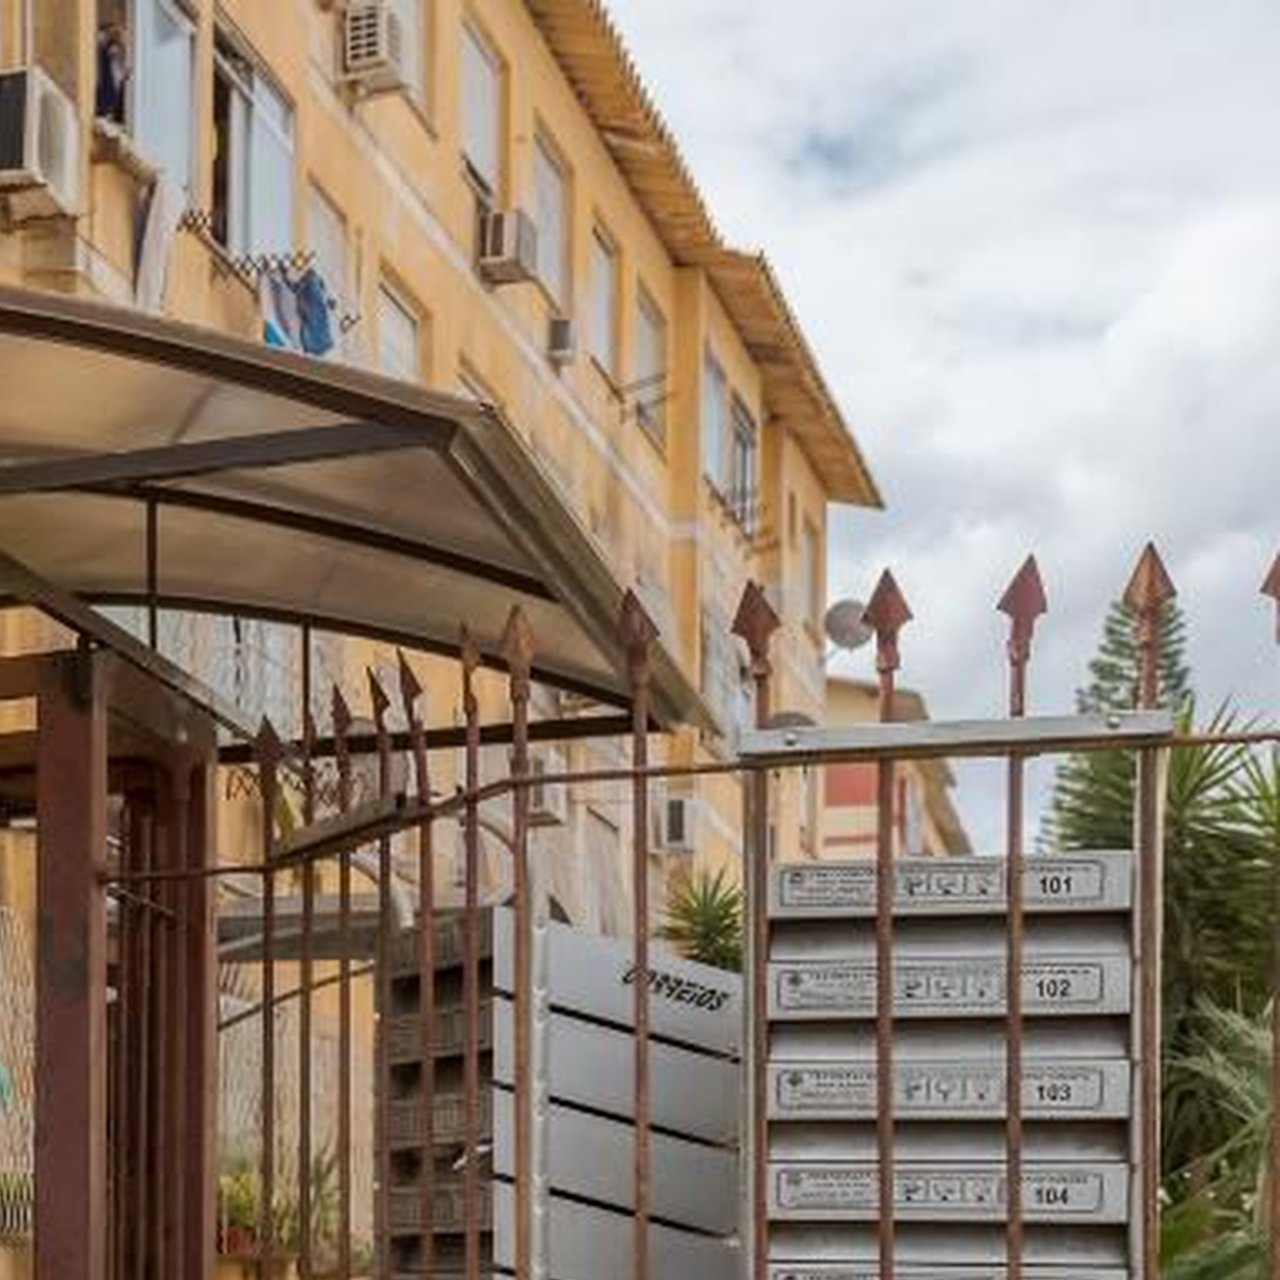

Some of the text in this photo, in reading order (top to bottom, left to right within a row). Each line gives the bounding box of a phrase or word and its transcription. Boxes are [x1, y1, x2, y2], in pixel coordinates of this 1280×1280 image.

[1039, 874, 1073, 894] 101
[1035, 978, 1072, 998] 102
[1037, 1082, 1072, 1101] 103
[1035, 1187, 1070, 1206] 104
